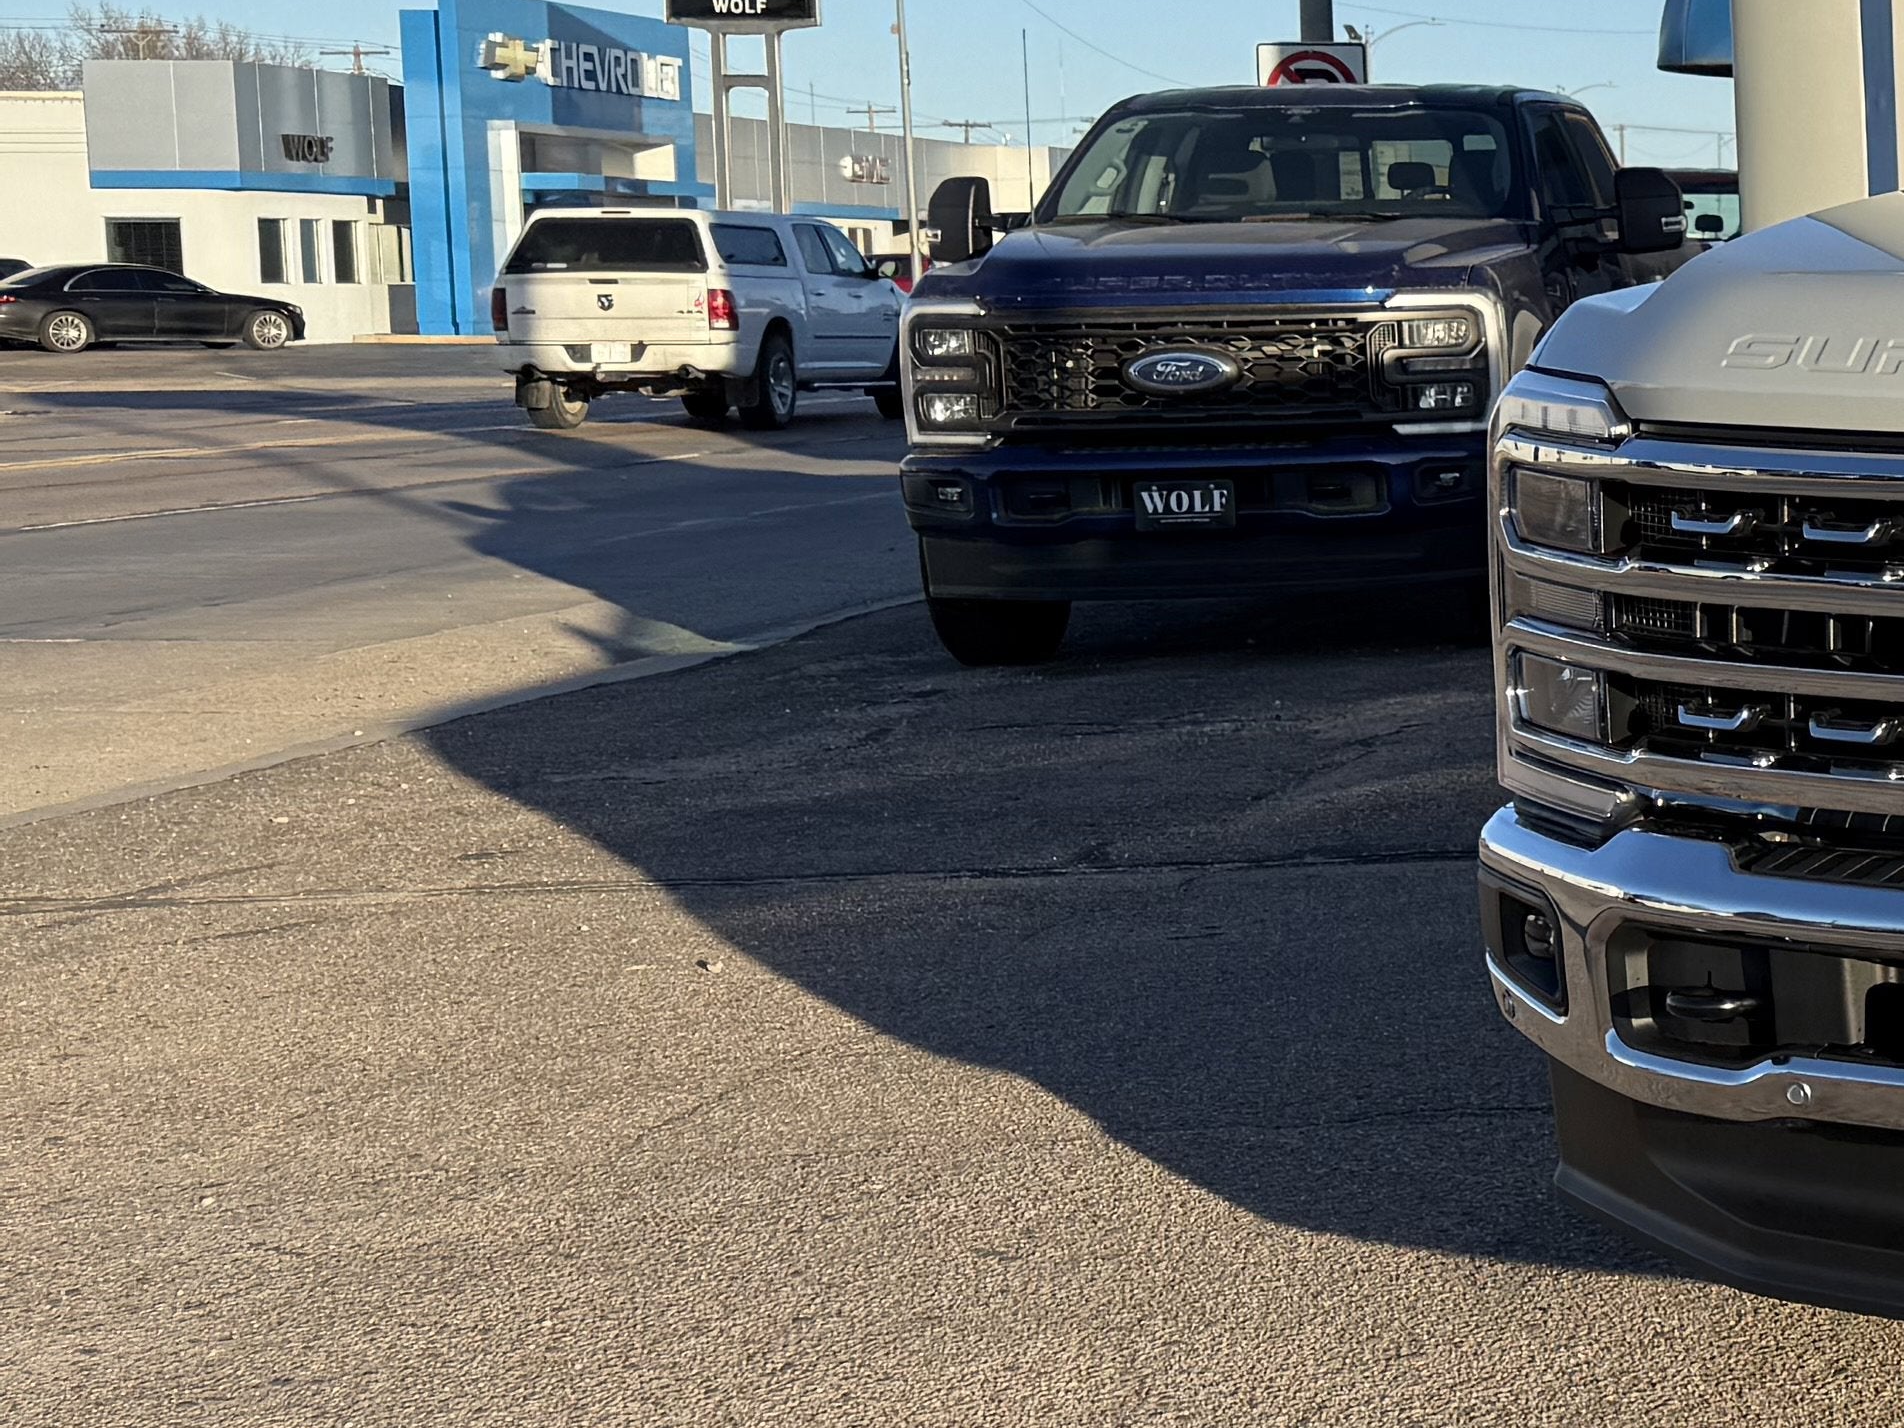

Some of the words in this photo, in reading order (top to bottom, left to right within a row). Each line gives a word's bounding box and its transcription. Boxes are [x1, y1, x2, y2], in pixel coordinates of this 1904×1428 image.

[541, 39, 683, 101] CHEVROLET
[281, 134, 334, 163] WOLF
[1152, 361, 1205, 381] Ford
[1141, 489, 1228, 514] WOLF
